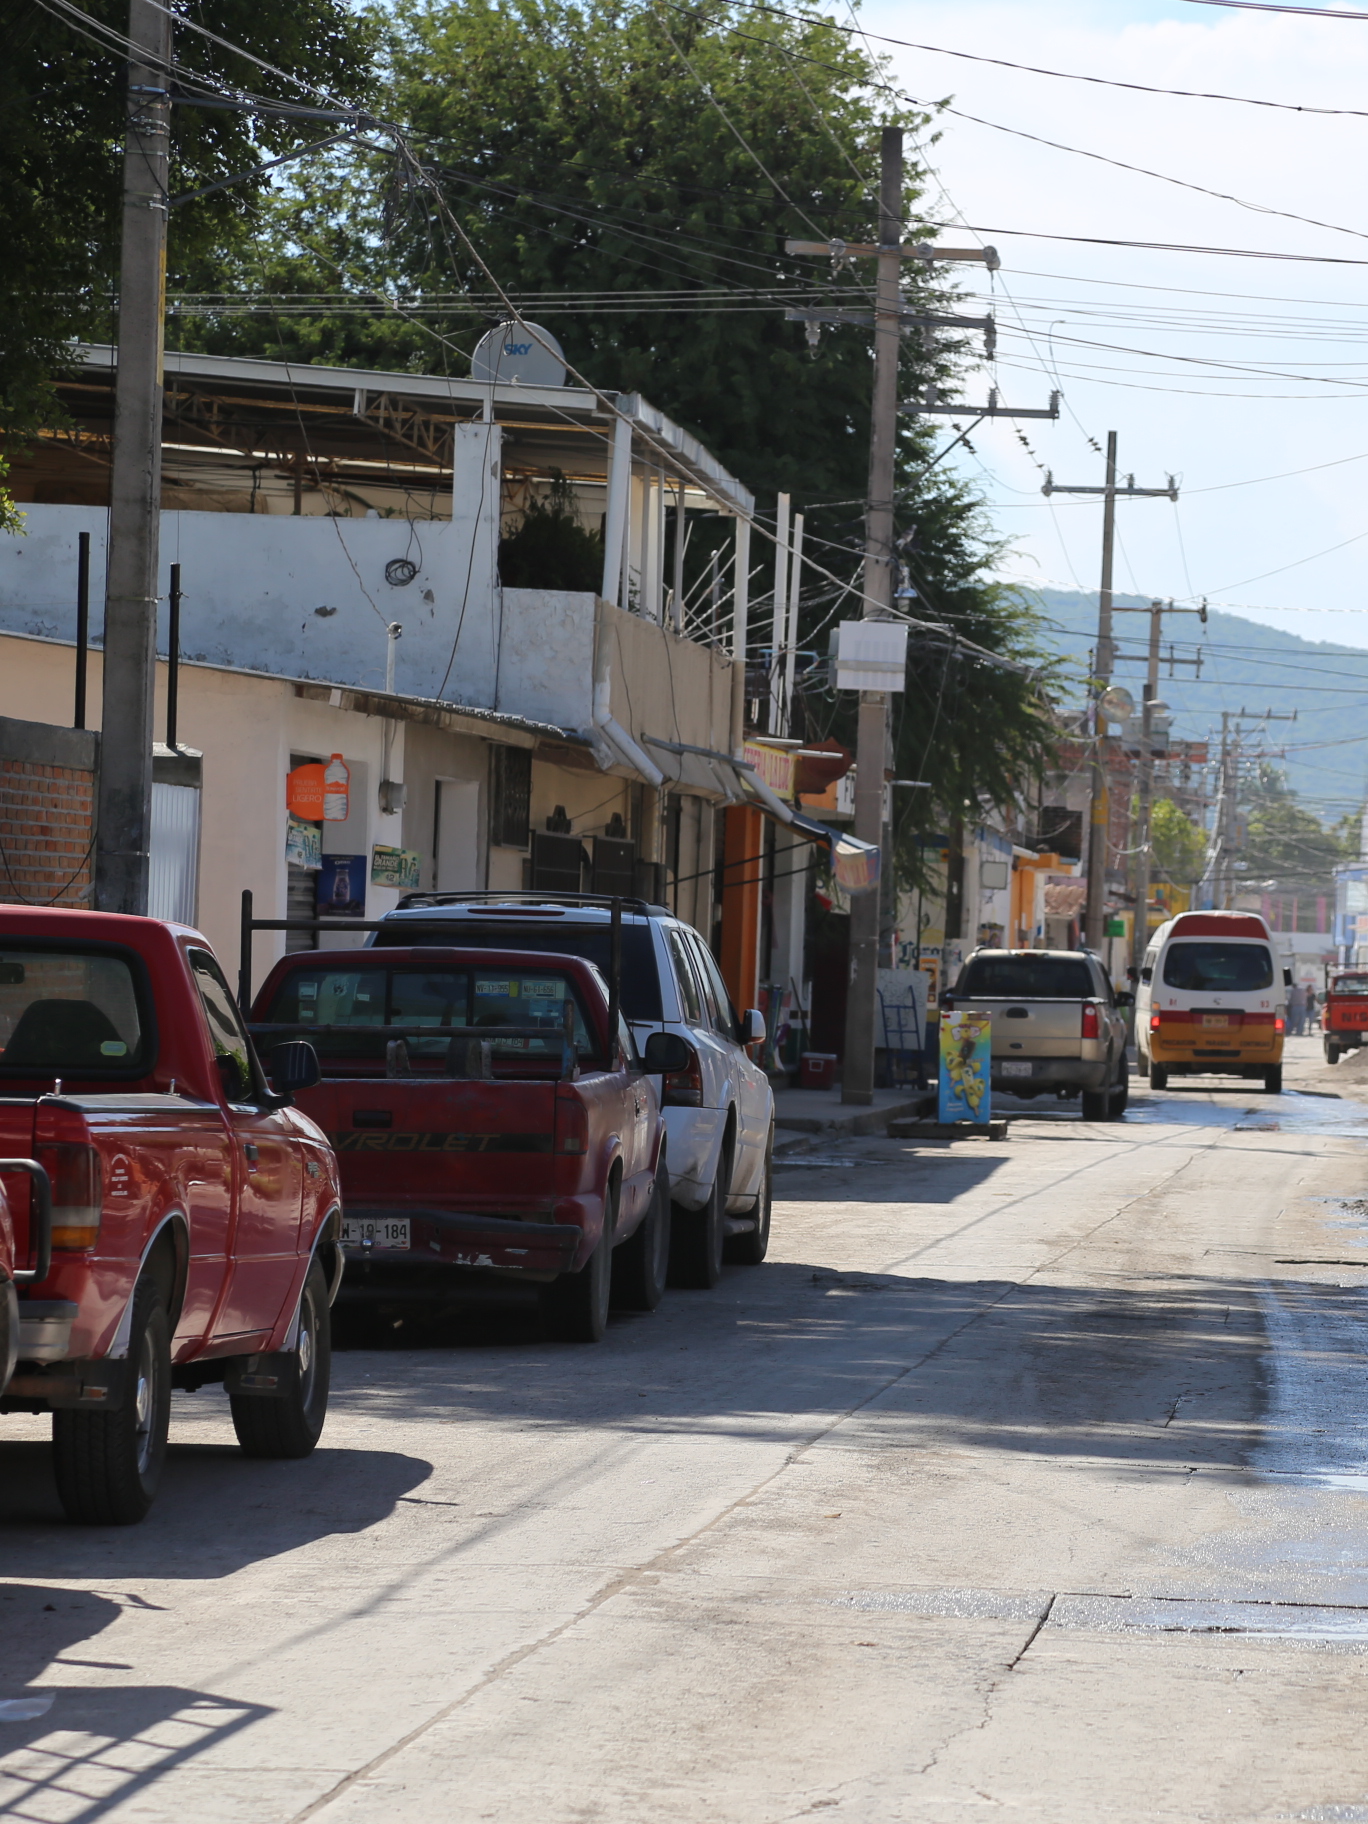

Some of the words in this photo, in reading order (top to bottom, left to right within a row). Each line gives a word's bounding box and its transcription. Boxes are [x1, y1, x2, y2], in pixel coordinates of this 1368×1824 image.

[504, 343, 533, 355] SKY
[292, 794, 322, 803] LIGERO
[374, 859, 399, 868] GRANDE
